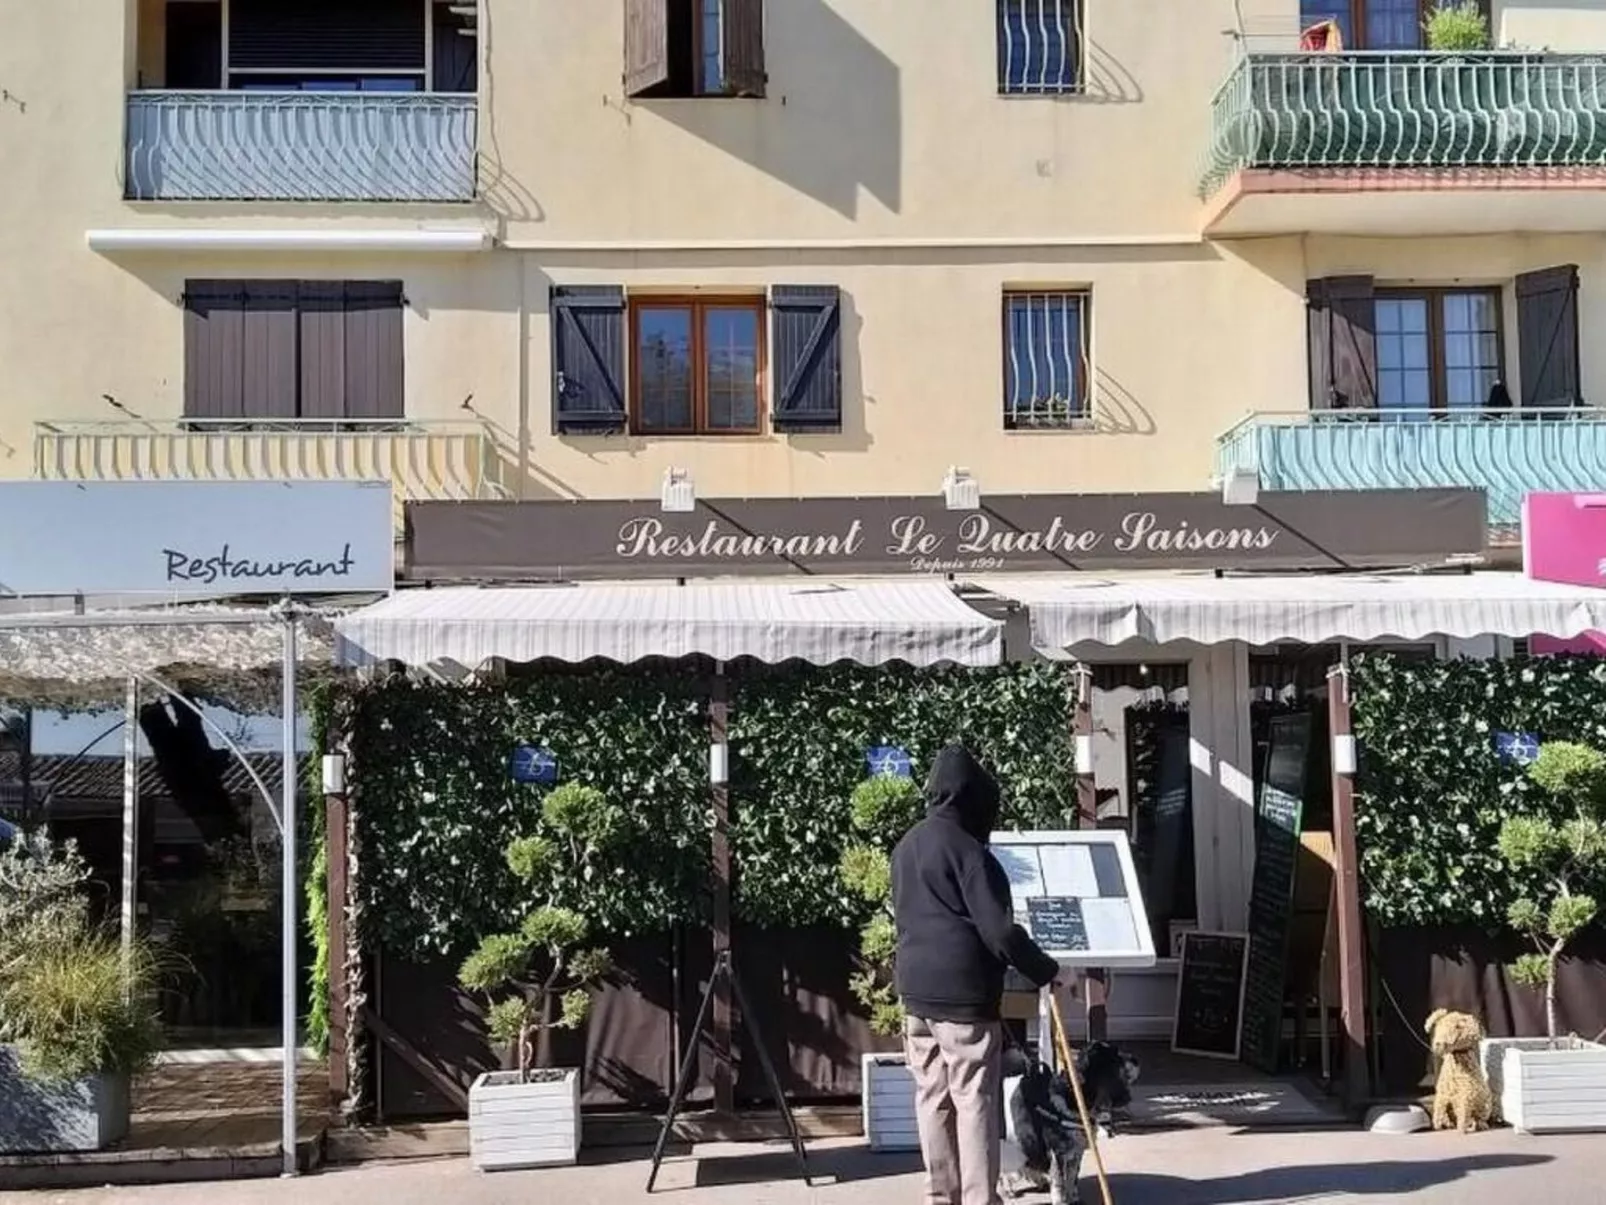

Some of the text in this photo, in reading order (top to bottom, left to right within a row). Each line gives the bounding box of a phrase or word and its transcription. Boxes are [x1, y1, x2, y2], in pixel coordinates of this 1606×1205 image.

[616, 512, 1280, 557] Restaurant Le Quatre Saisons
[162, 543, 355, 584] Restaurant
[910, 555, 1004, 574] Depuis 1991
